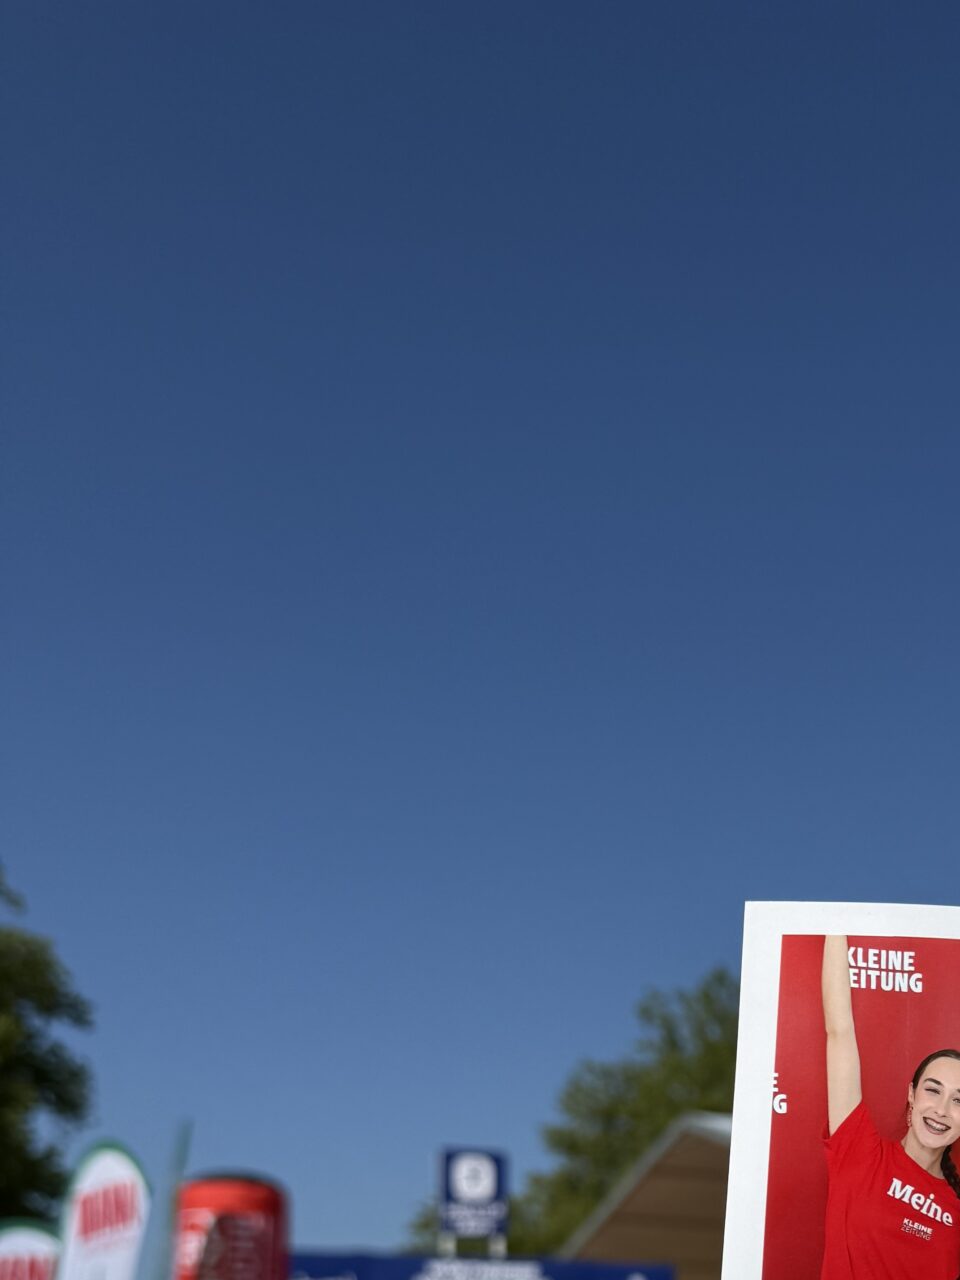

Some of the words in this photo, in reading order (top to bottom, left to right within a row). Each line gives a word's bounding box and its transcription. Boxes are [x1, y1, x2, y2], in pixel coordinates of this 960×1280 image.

[847, 946, 915, 971] KLEINE
[849, 967, 923, 993] EITUNG
[887, 1177, 953, 1227] Meine
[902, 1217, 934, 1235] KLEINE
